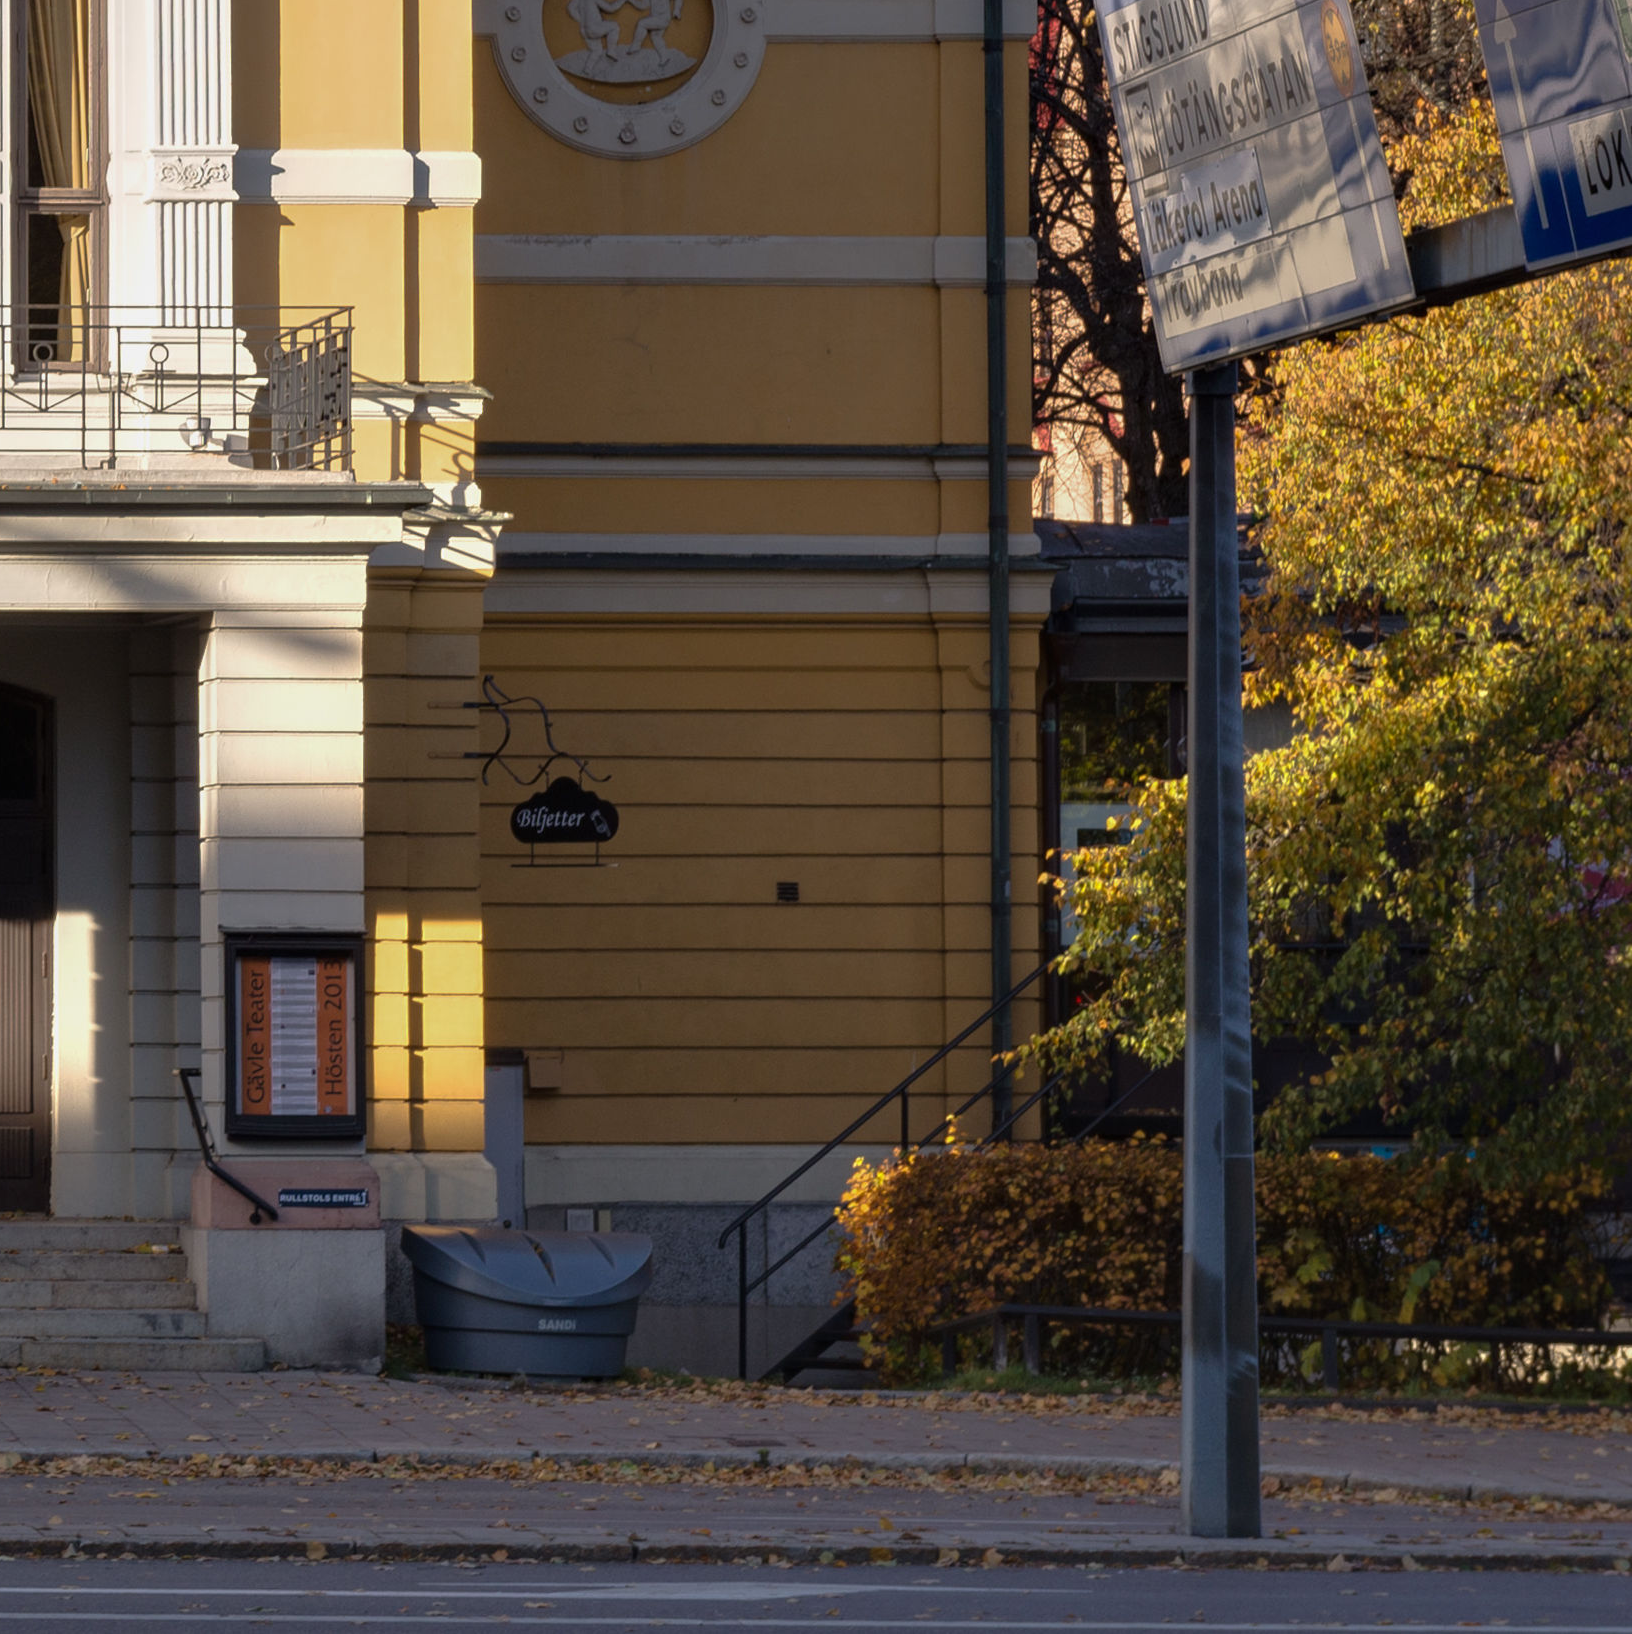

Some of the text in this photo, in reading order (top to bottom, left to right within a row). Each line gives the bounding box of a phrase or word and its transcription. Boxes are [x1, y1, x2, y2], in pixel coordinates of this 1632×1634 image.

[1159, 50, 1312, 157] LÖTÄNGSGATAN
[1579, 126, 1632, 195] LOK
[1143, 179, 1264, 255] Läkerol Arena
[1158, 262, 1243, 323] Travbana
[517, 806, 585, 834] Biljetter
[247, 970, 265, 1103] Gävle Teater
[324, 958, 343, 1095] Hösten 2013
[279, 1193, 331, 1202] RULLSTOLS
